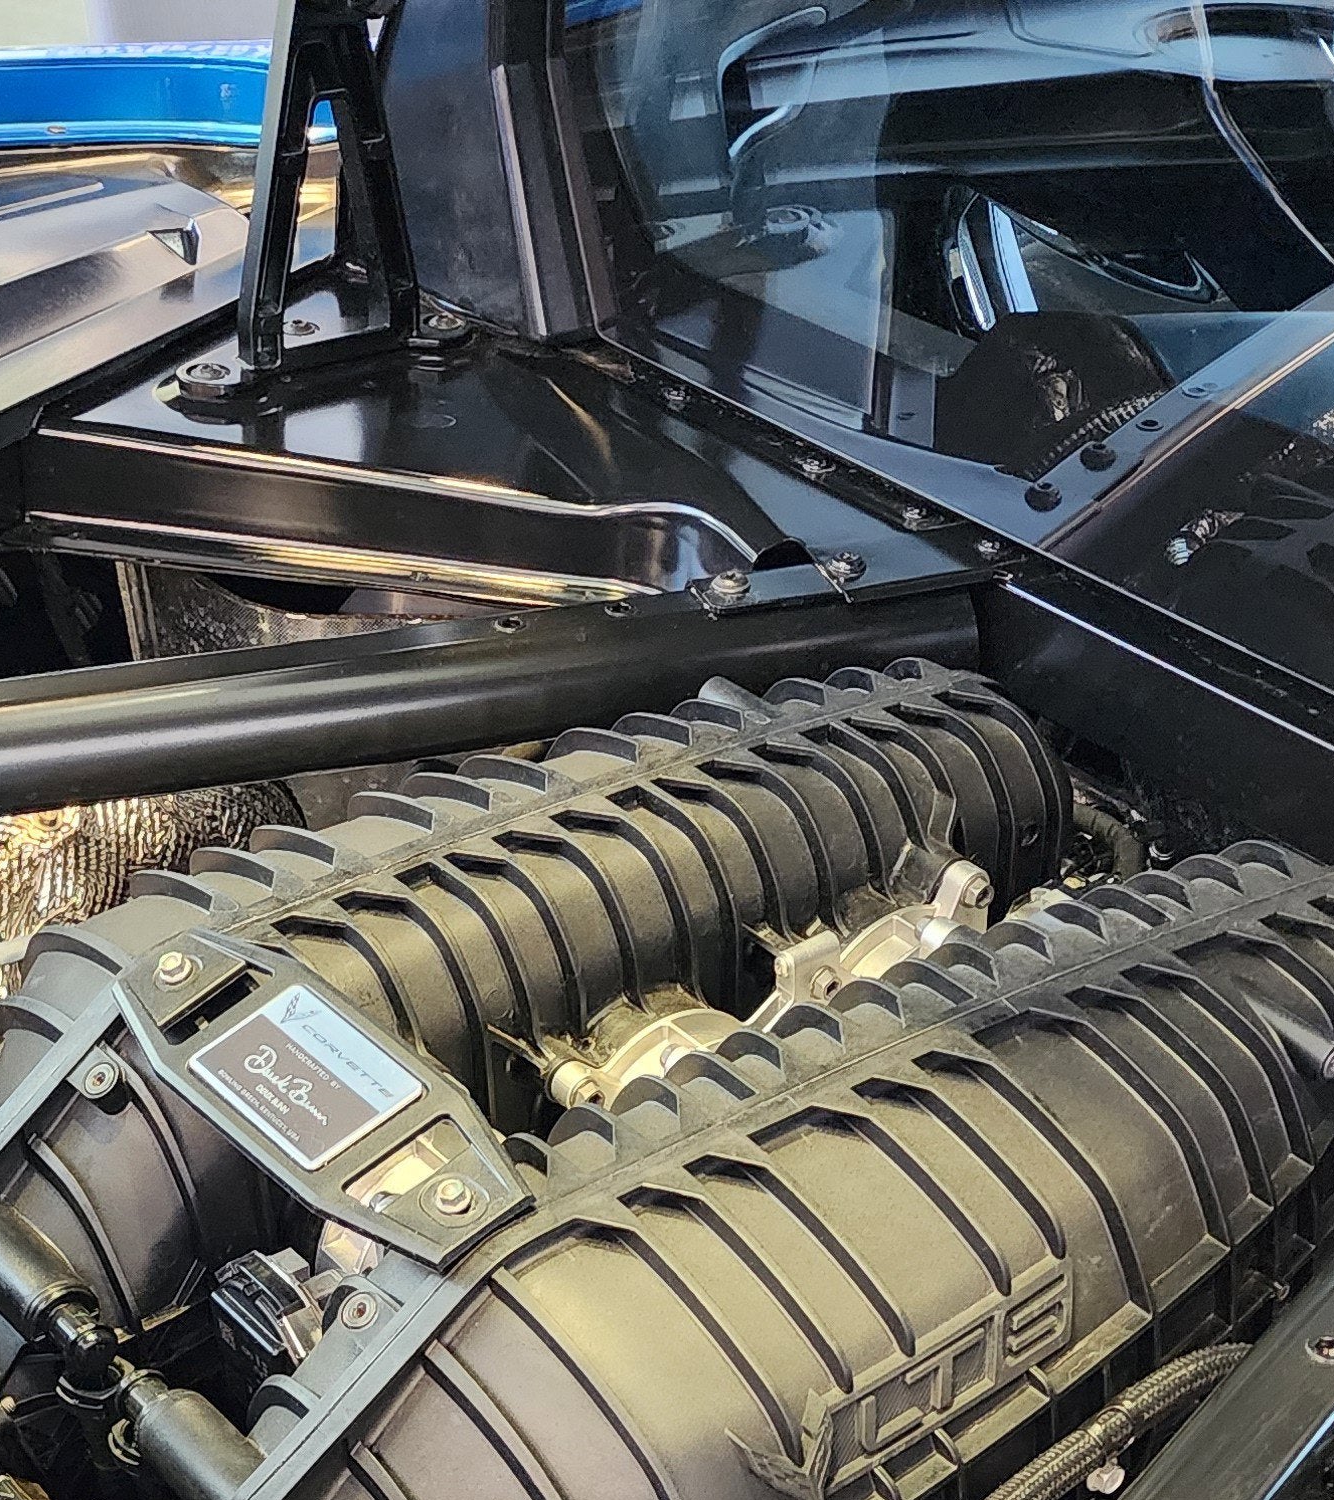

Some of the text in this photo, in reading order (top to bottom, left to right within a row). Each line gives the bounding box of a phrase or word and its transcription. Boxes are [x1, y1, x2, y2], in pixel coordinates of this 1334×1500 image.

[285, 1043, 342, 1090] HANDCRAFTED BY
[302, 1024, 394, 1098] CORVETTE
